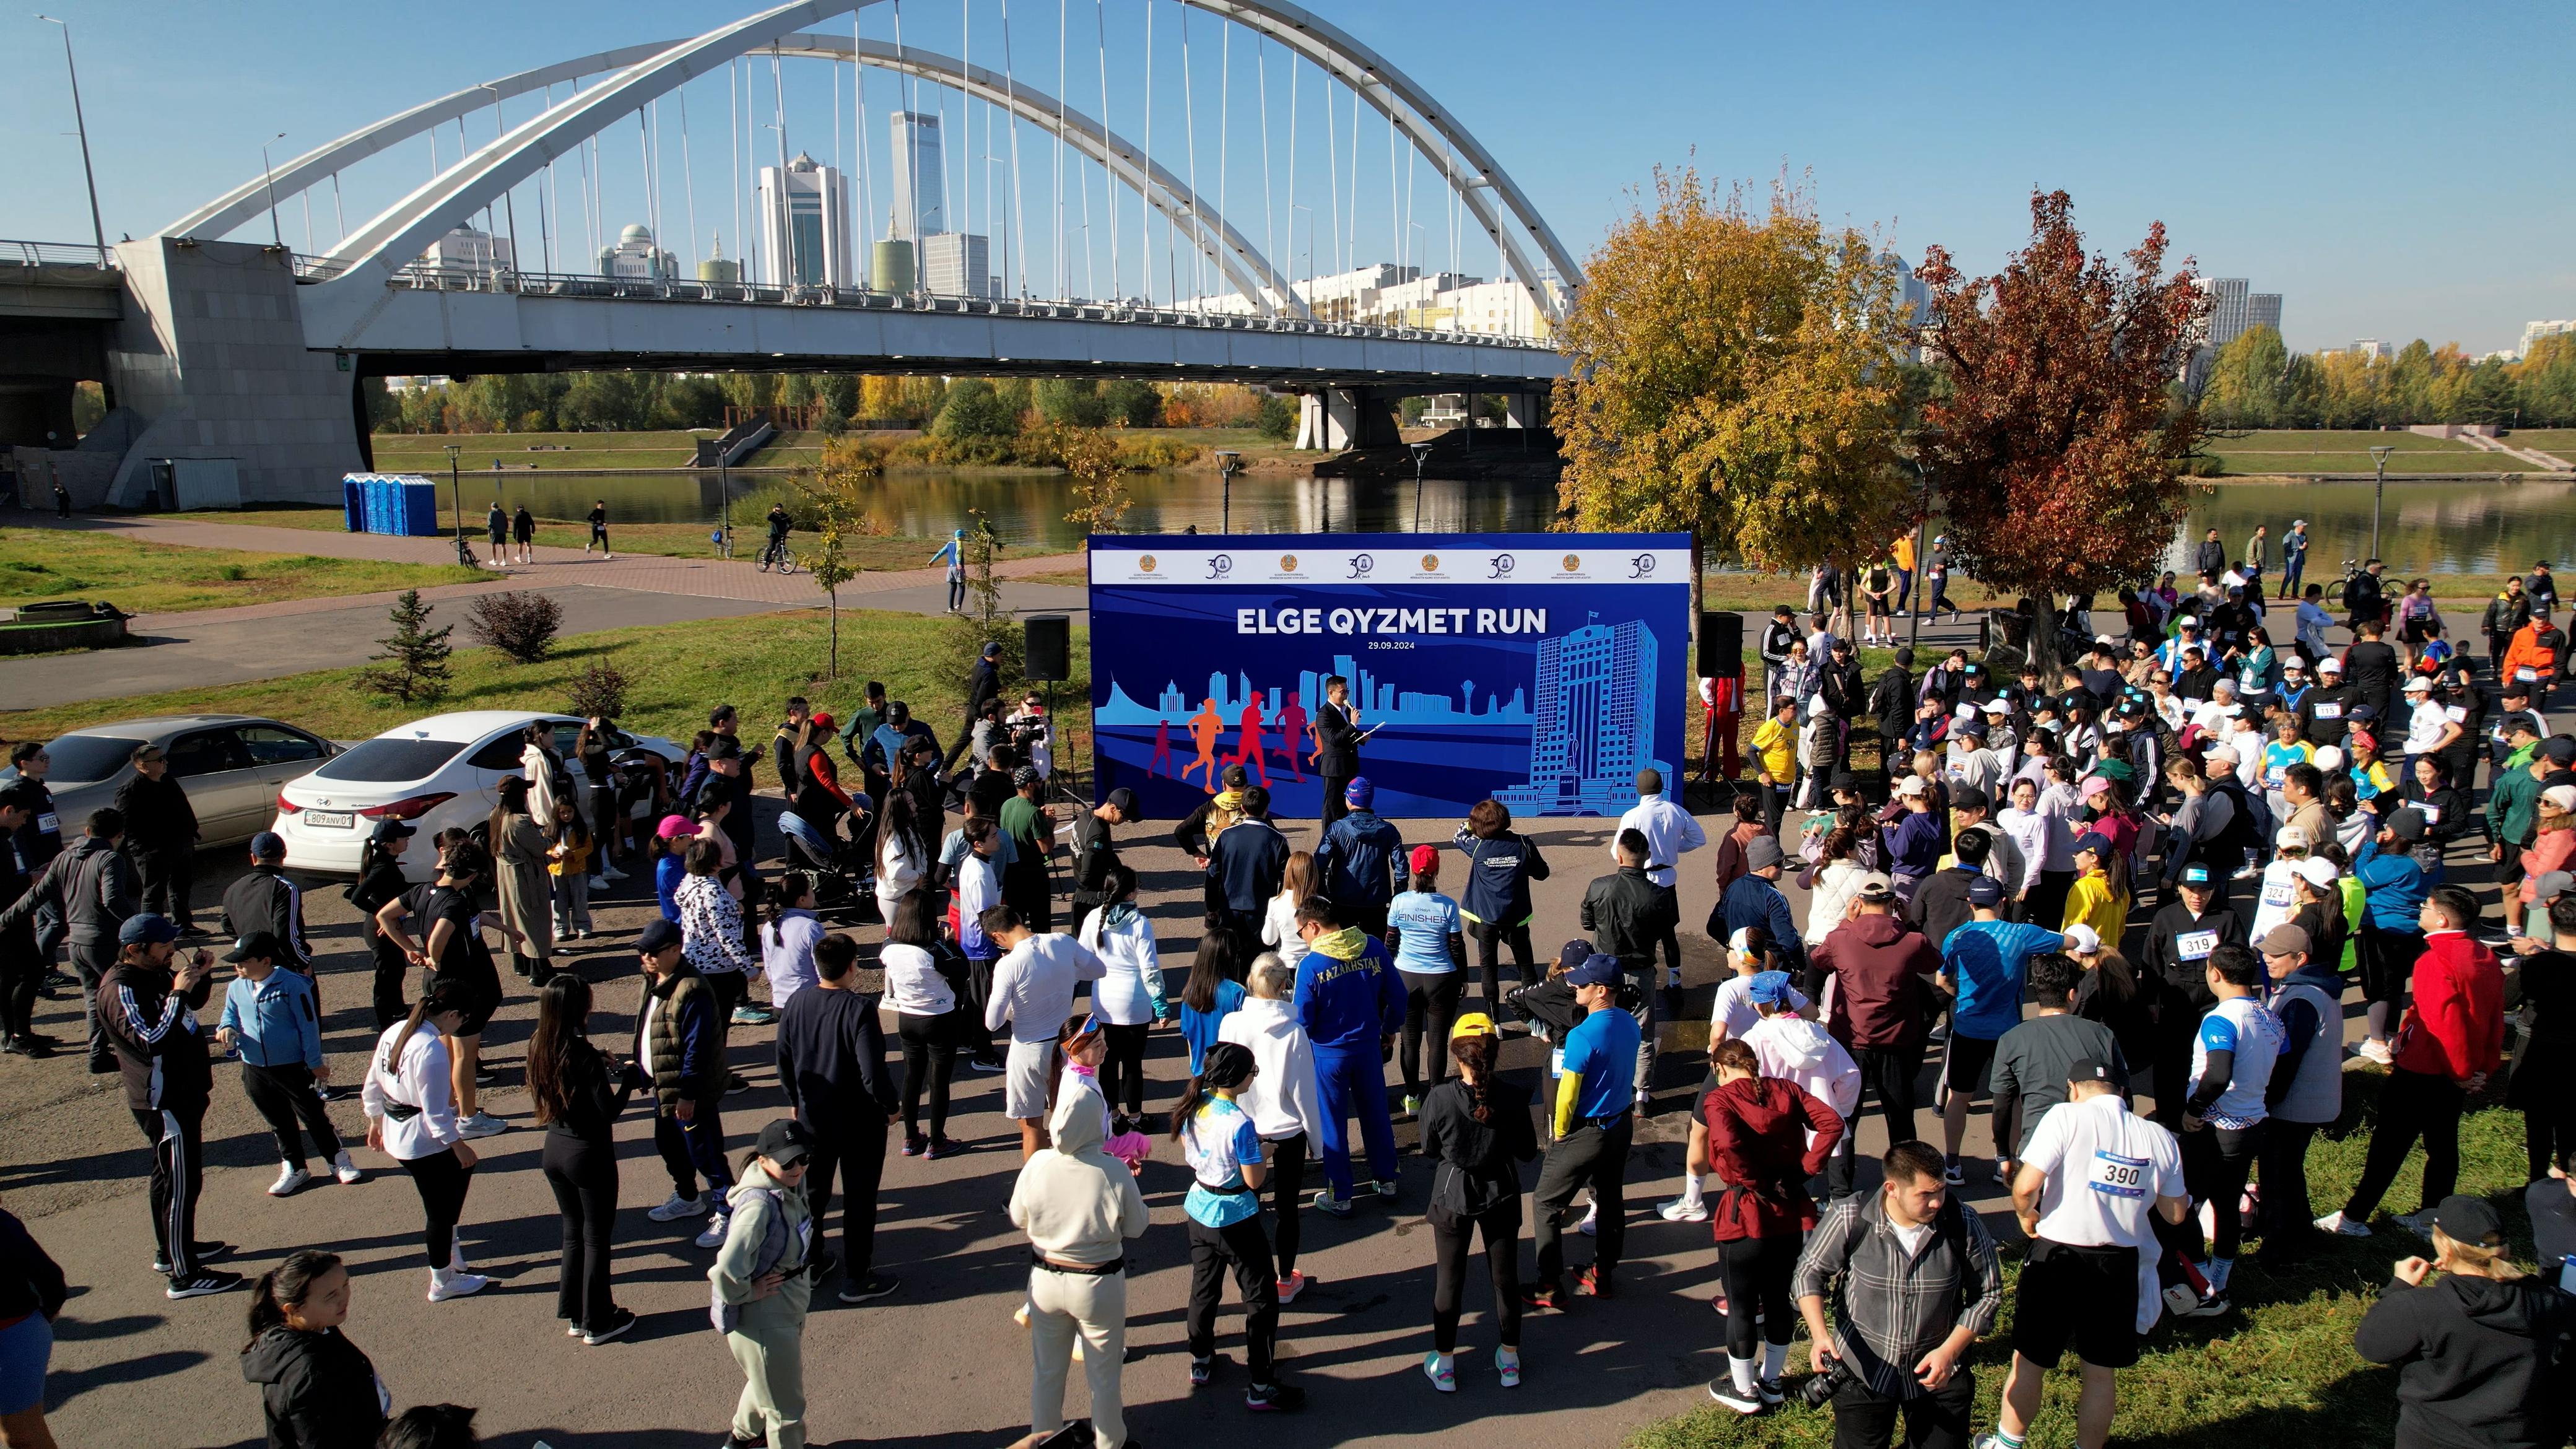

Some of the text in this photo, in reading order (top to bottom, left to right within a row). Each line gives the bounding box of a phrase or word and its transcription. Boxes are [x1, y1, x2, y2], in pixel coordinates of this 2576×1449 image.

[1237, 609, 1546, 635] ELGE QYZMET RUN
[1368, 642, 1415, 650] 29.09.2024
[1786, 739, 1795, 750] 50
[311, 814, 326, 824] 809
[341, 816, 352, 825] 01
[2268, 887, 2283, 899] 324
[1398, 913, 1448, 924] FINISHER
[2187, 938, 2209, 952] 319
[1317, 957, 1380, 984] KAZAKHSTAN
[2105, 1165, 2140, 1185] 390
